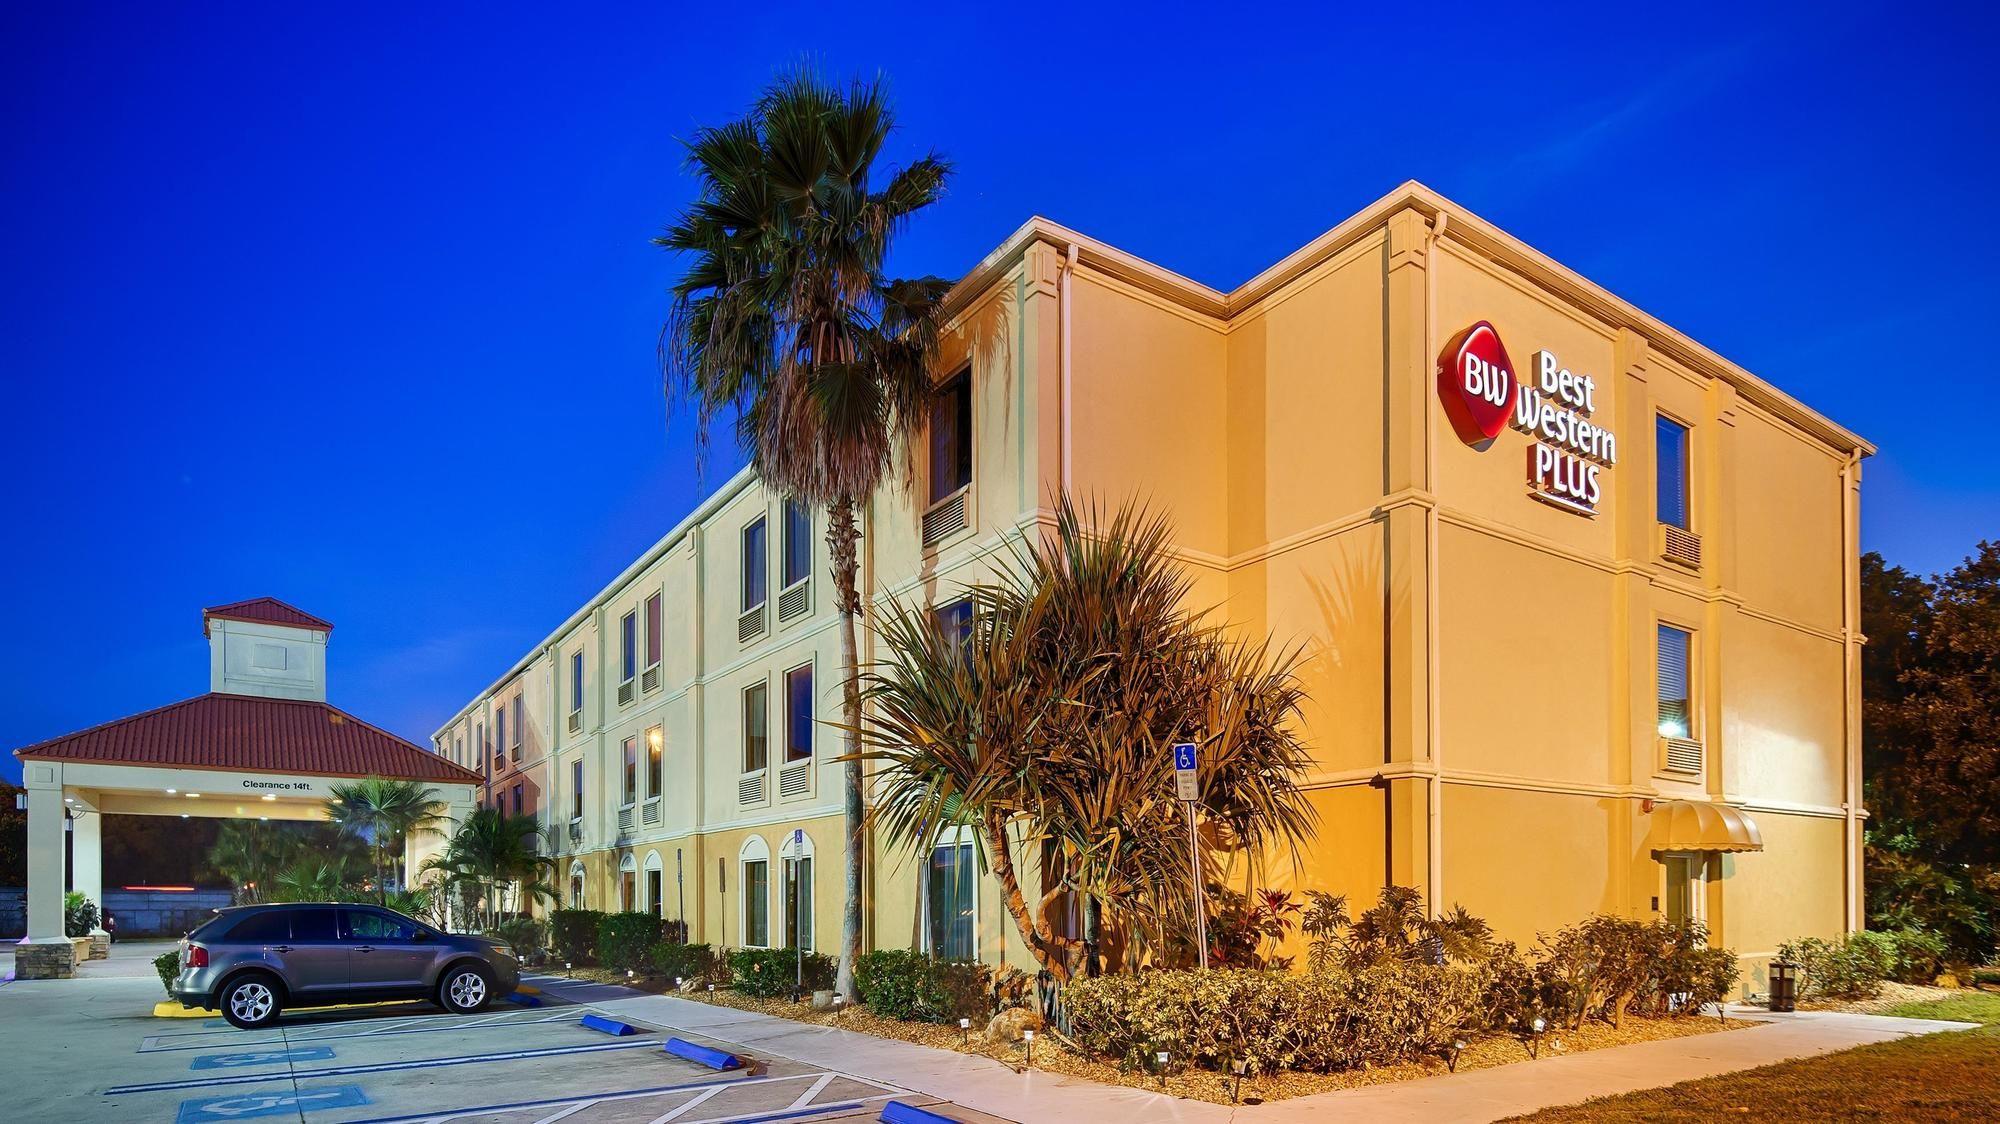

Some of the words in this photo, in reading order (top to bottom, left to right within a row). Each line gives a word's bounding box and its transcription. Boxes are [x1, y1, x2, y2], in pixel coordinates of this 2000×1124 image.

[1465, 351, 1508, 407] BW
[1539, 350, 1595, 413] Best
[1516, 382, 1617, 465] Western
[1535, 443, 1600, 505] PLUS
[242, 780, 291, 790] Clearance
[293, 782, 313, 791] 14ft.
